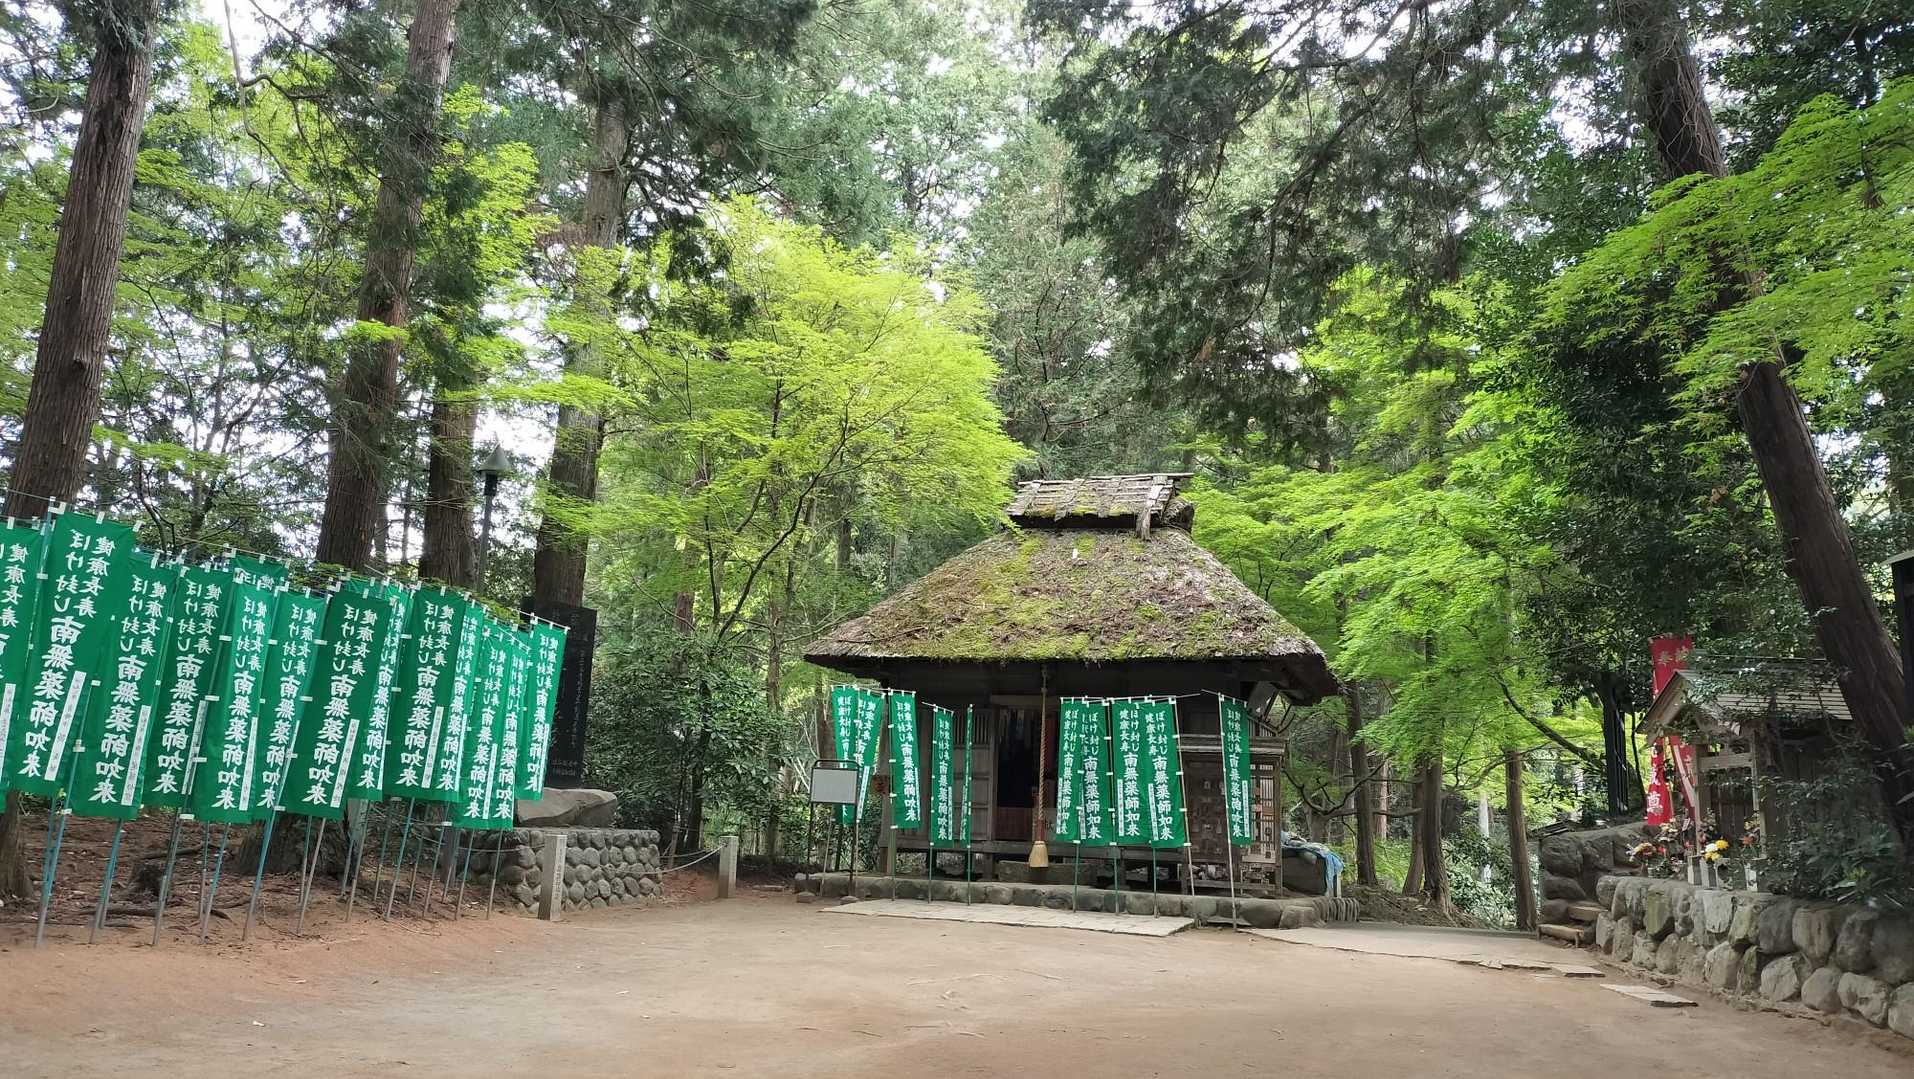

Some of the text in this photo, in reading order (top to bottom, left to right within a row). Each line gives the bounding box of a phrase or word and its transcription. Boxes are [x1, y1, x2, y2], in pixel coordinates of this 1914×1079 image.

[1084, 755, 1102, 840] 南無薬師如来
[1123, 752, 1141, 837] 南無薬師如来
[1152, 756, 1174, 841] 南無薬師如来
